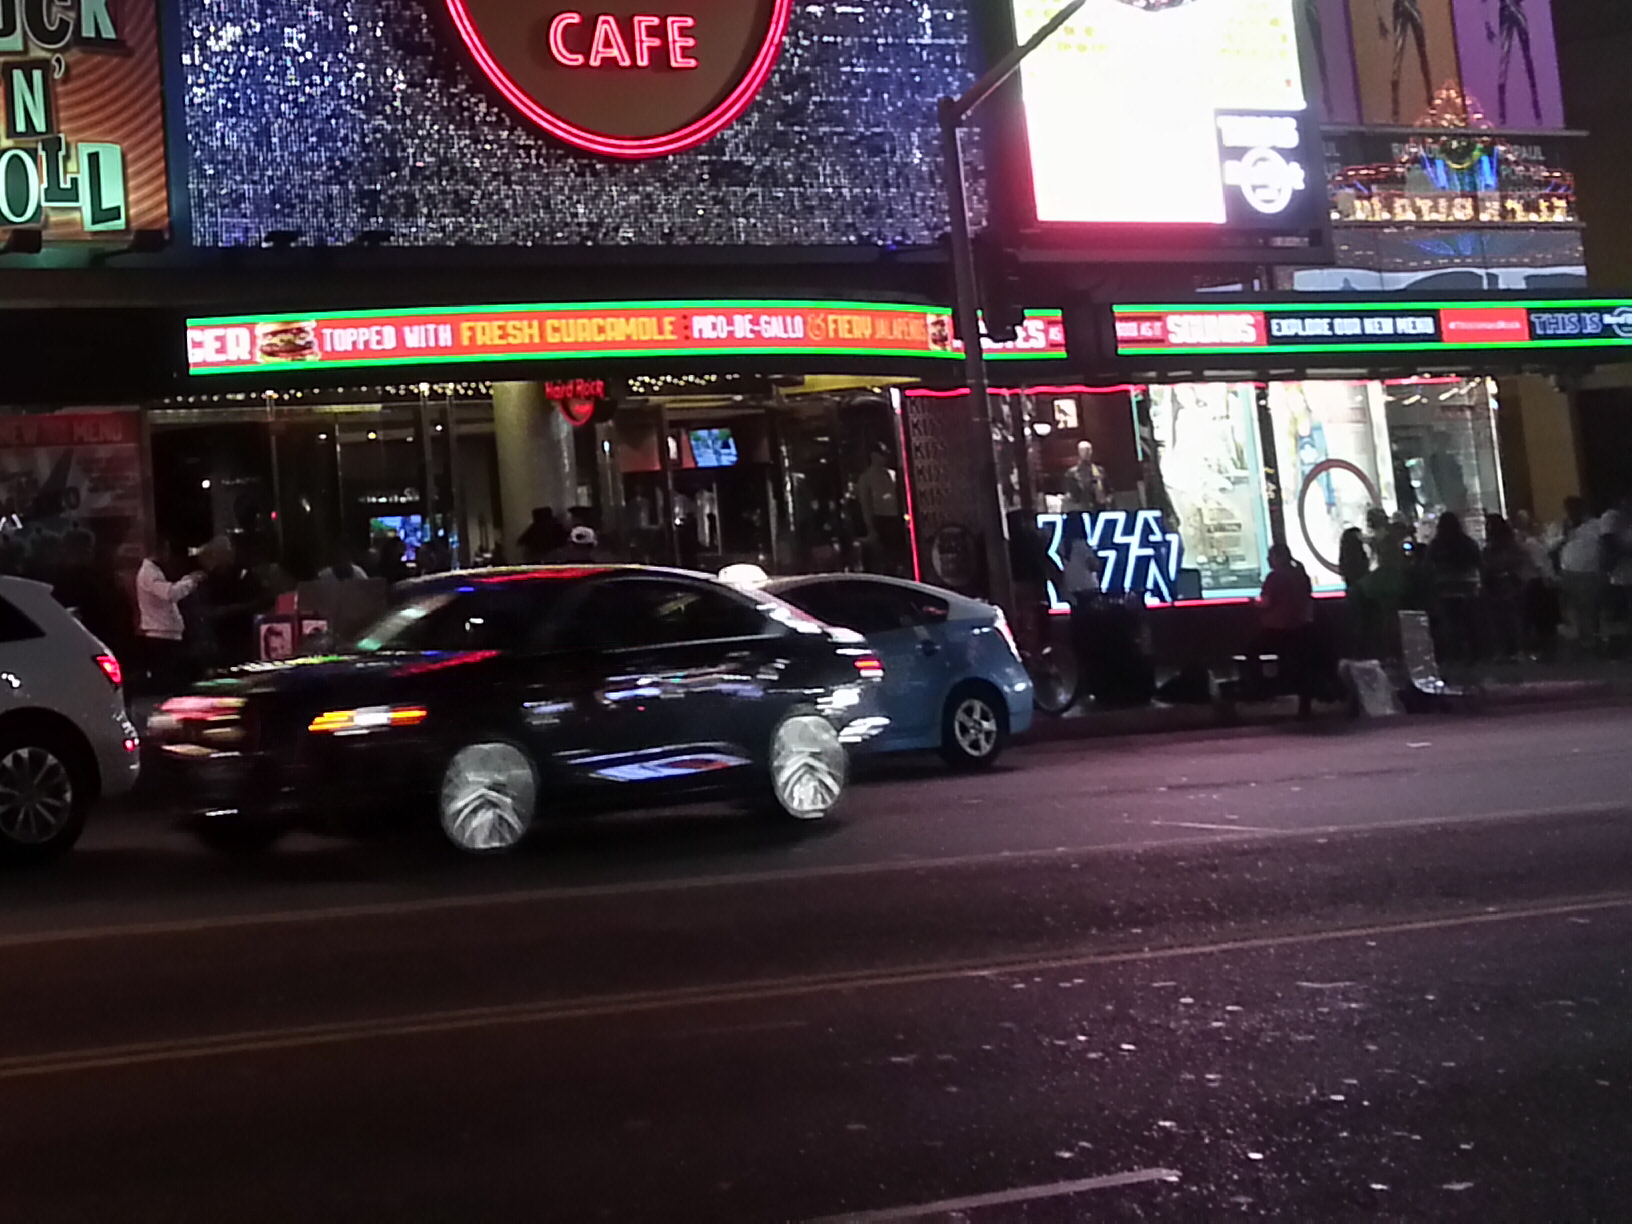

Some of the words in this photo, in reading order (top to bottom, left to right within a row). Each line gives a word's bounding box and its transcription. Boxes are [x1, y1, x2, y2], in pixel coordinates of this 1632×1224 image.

[549, 12, 699, 69] CAFE
[321, 325, 397, 353] TOPPED
[402, 323, 452, 348] WITH
[460, 320, 540, 346] FRESH
[545, 315, 676, 344] GUACAMOLE
[691, 313, 804, 341] PICO-DE-GALLO
[1530, 312, 1580, 336] THIS
[1582, 312, 1603, 334] IS
